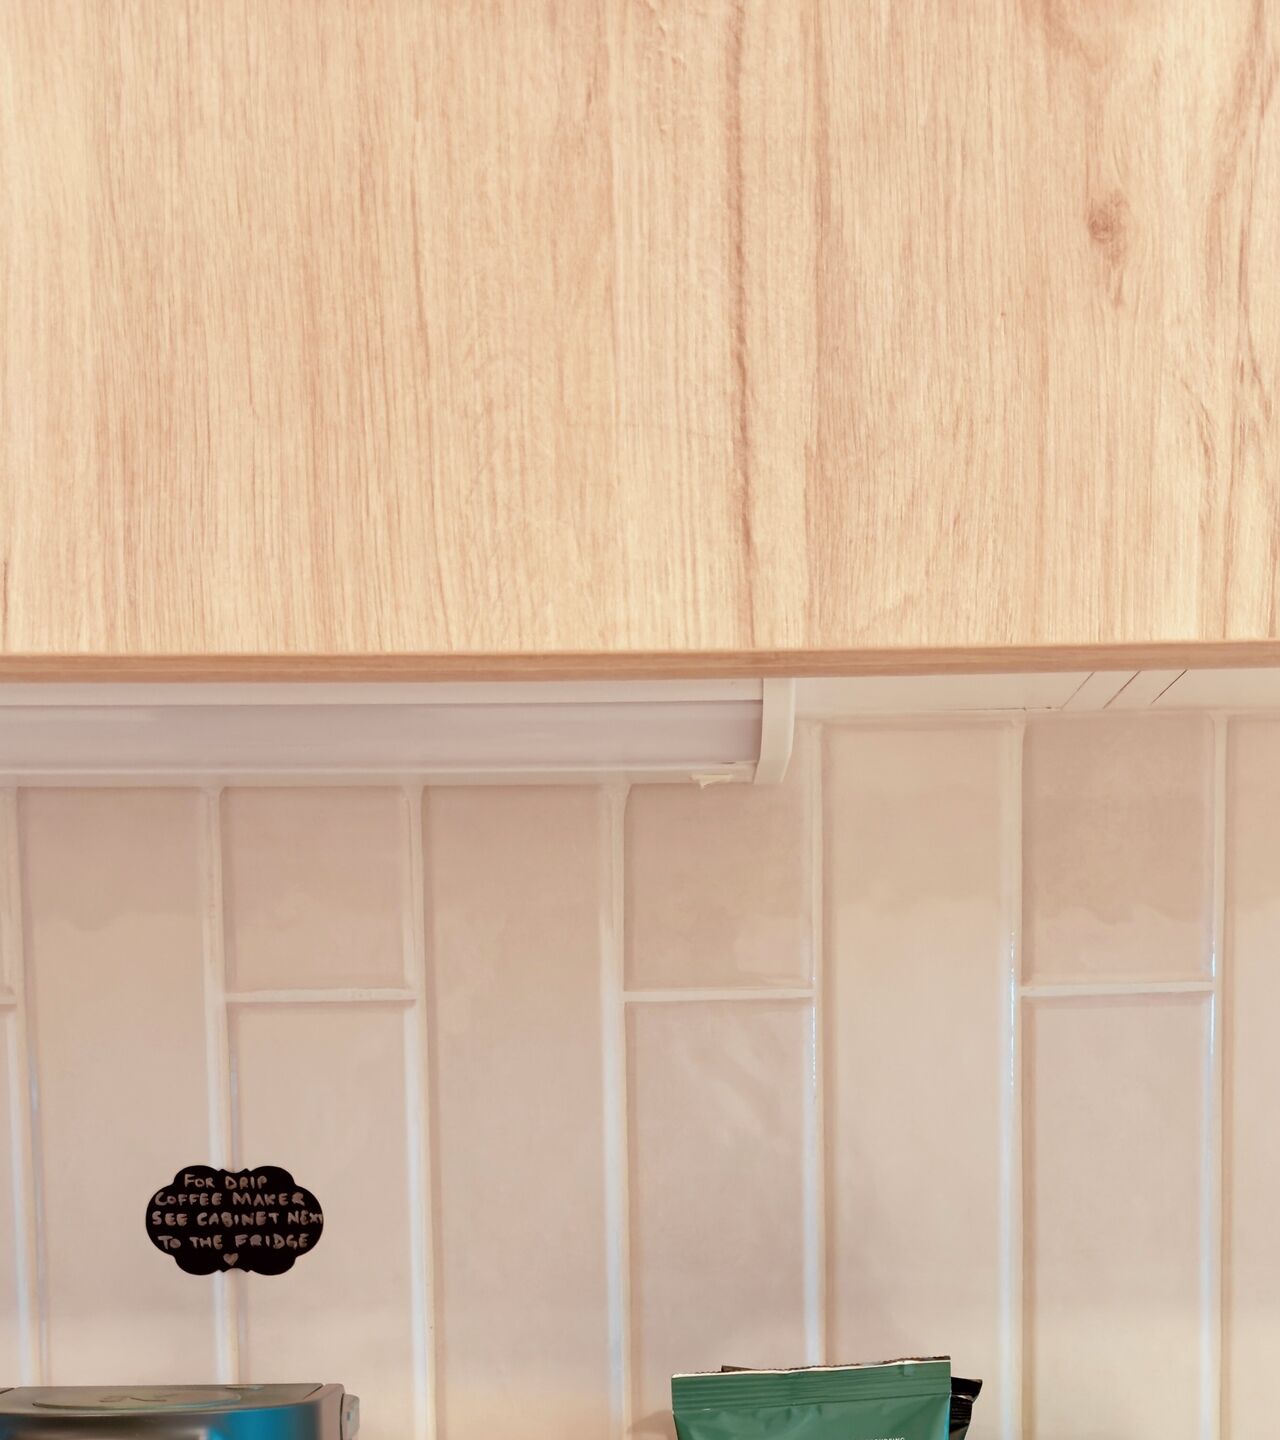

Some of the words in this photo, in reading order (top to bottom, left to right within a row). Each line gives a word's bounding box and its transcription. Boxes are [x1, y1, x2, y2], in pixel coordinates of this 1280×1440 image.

[184, 1174, 215, 1188] FOR
[225, 1175, 267, 1190] DRIP
[154, 1191, 222, 1206] COFFEE
[232, 1192, 305, 1206] MAKER
[152, 1211, 187, 1226] SEE
[197, 1211, 280, 1227] CABINET
[287, 1210, 323, 1225] NEXT
[158, 1235, 182, 1250] TO
[189, 1234, 223, 1249] THE
[234, 1233, 309, 1249] FRIDGE
